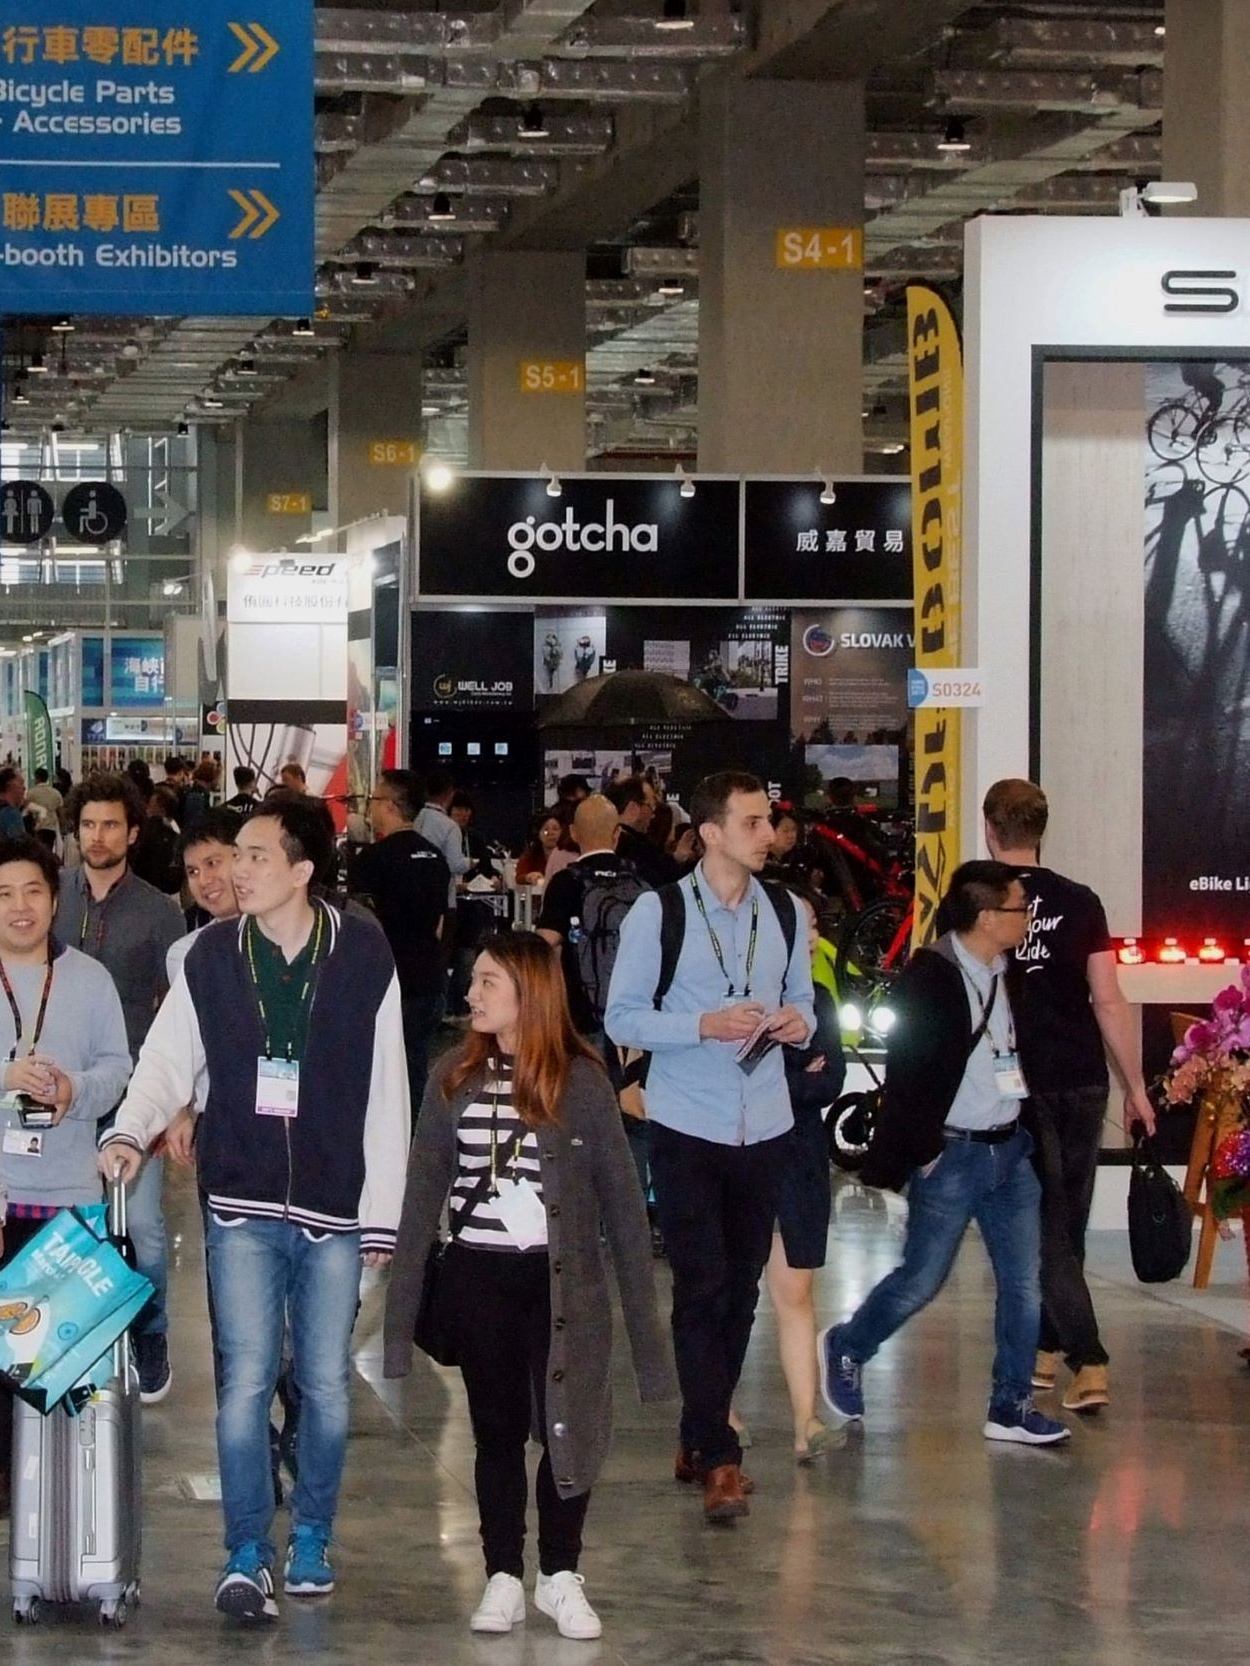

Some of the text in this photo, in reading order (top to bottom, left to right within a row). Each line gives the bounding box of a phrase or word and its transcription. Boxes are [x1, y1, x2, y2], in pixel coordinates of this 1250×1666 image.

[96, 80, 175, 105] Parts
[12, 110, 182, 136] Accessories
[2, 191, 160, 234] 聯展專區
[96, 243, 238, 269] Exhibitors
[783, 232, 855, 265] S4-1
[525, 366, 581, 390] S5-1
[372, 443, 417, 464] S6-1
[269, 495, 310, 513] S7-1
[506, 498, 659, 579] gotcha
[795, 528, 905, 553] 威嘉貿易
[840, 632, 904, 649] SLOVAK
[774, 644, 789, 685] TRIKE
[457, 680, 514, 692] WELL JOB
[931, 682, 982, 697] S0324
[1189, 876, 1250, 893] eBike Li
